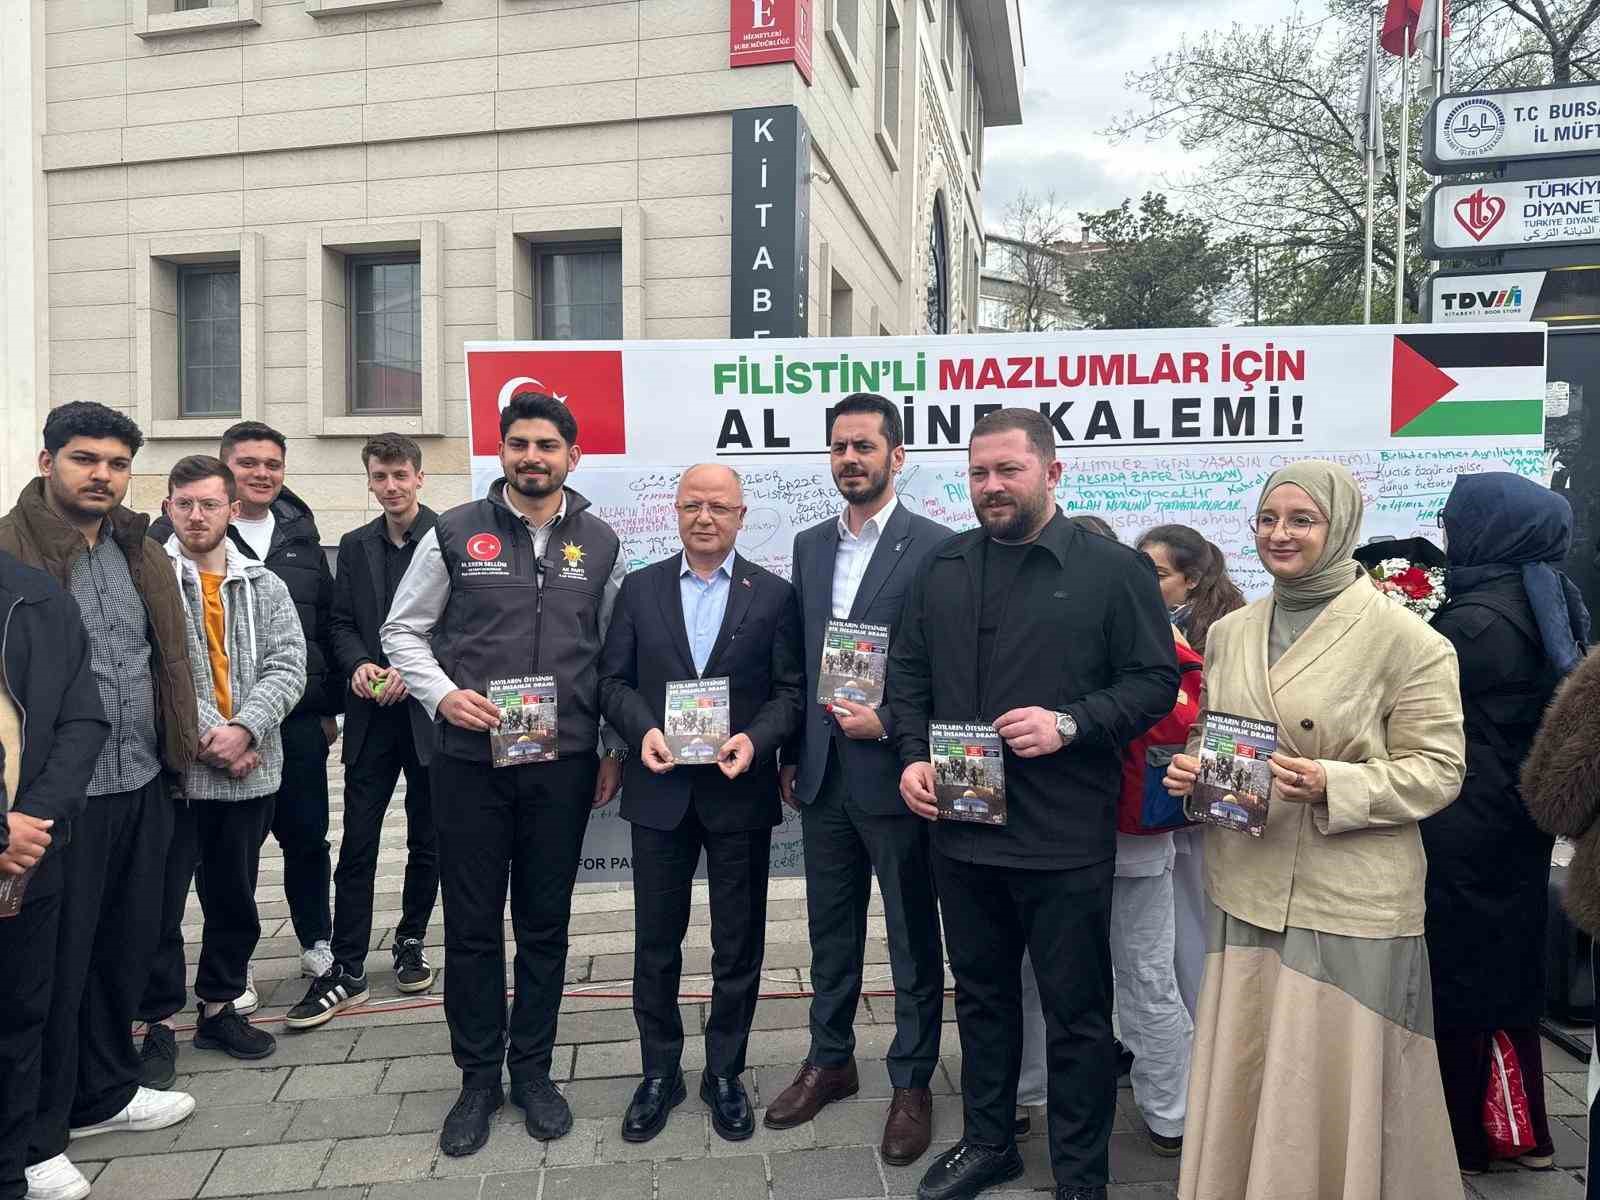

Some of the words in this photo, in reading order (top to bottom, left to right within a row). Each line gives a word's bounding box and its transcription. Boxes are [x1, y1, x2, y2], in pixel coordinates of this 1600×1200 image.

[1514, 106, 1538, 121] T.C
[1549, 101, 1600, 119] BURS
[1534, 125, 1548, 143] İL
[714, 352, 926, 394] FİLİSTİN'Lİ
[939, 352, 1209, 391] MAZLUMLAR
[1221, 343, 1305, 391] İÇİN
[716, 408, 790, 448] AL
[1039, 386, 1303, 441] KALEMİ!
[610, 856, 632, 870] PA
